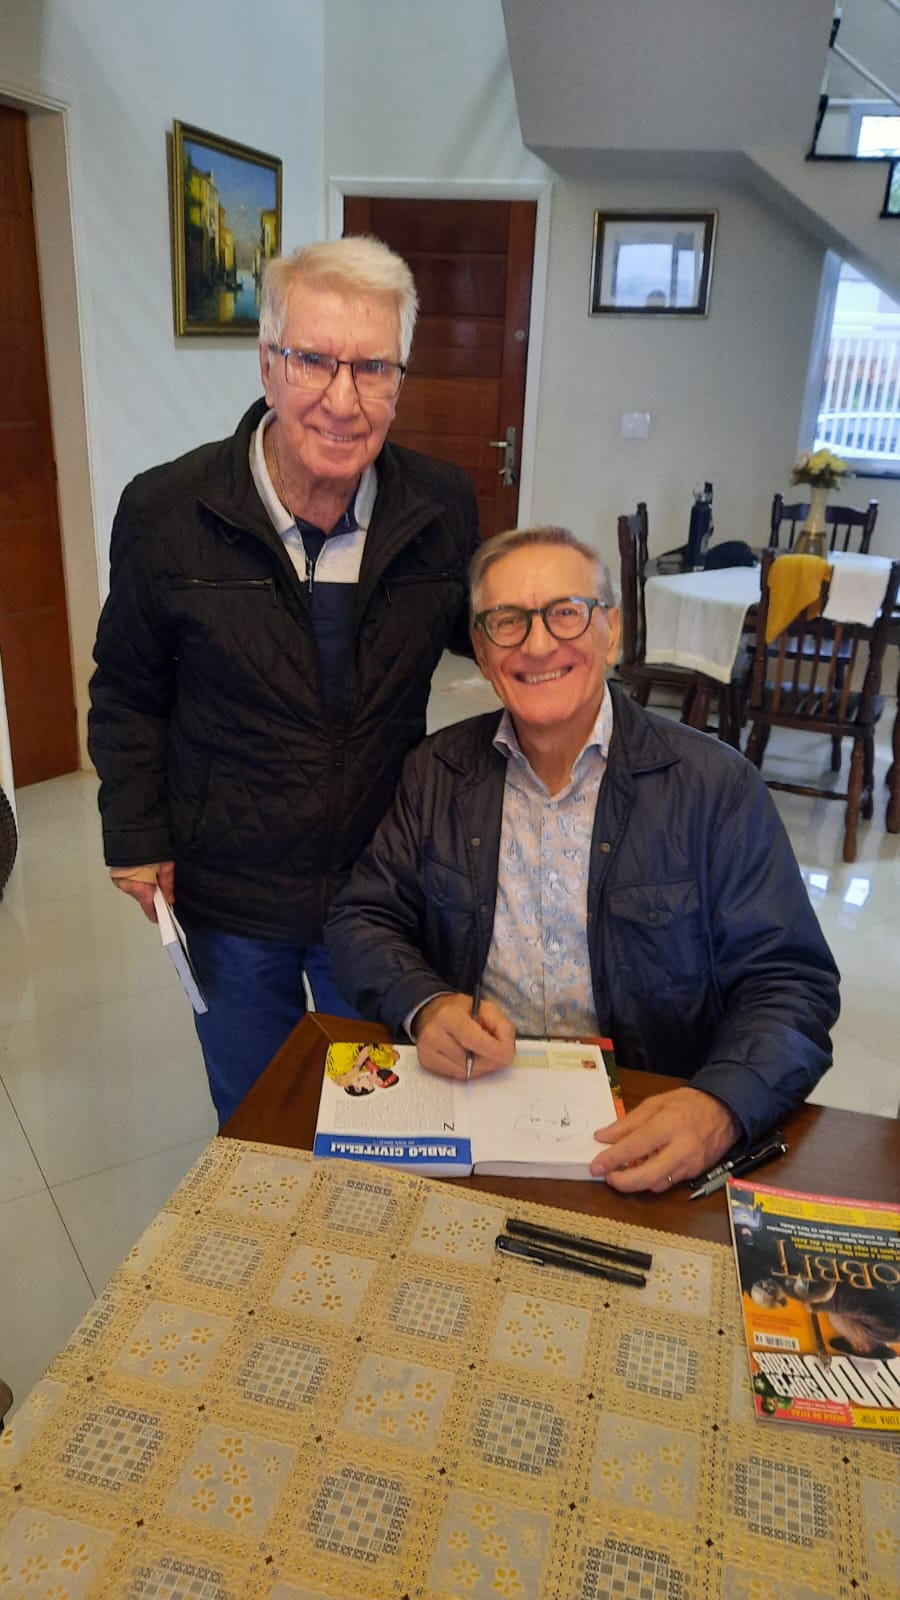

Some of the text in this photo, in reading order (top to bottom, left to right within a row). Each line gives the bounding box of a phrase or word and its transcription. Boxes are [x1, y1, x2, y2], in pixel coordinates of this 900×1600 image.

[330, 1141, 404, 1157] CIVITELLI
[408, 1145, 457, 1158] PABLO
[765, 1372, 826, 1402] SUPER
